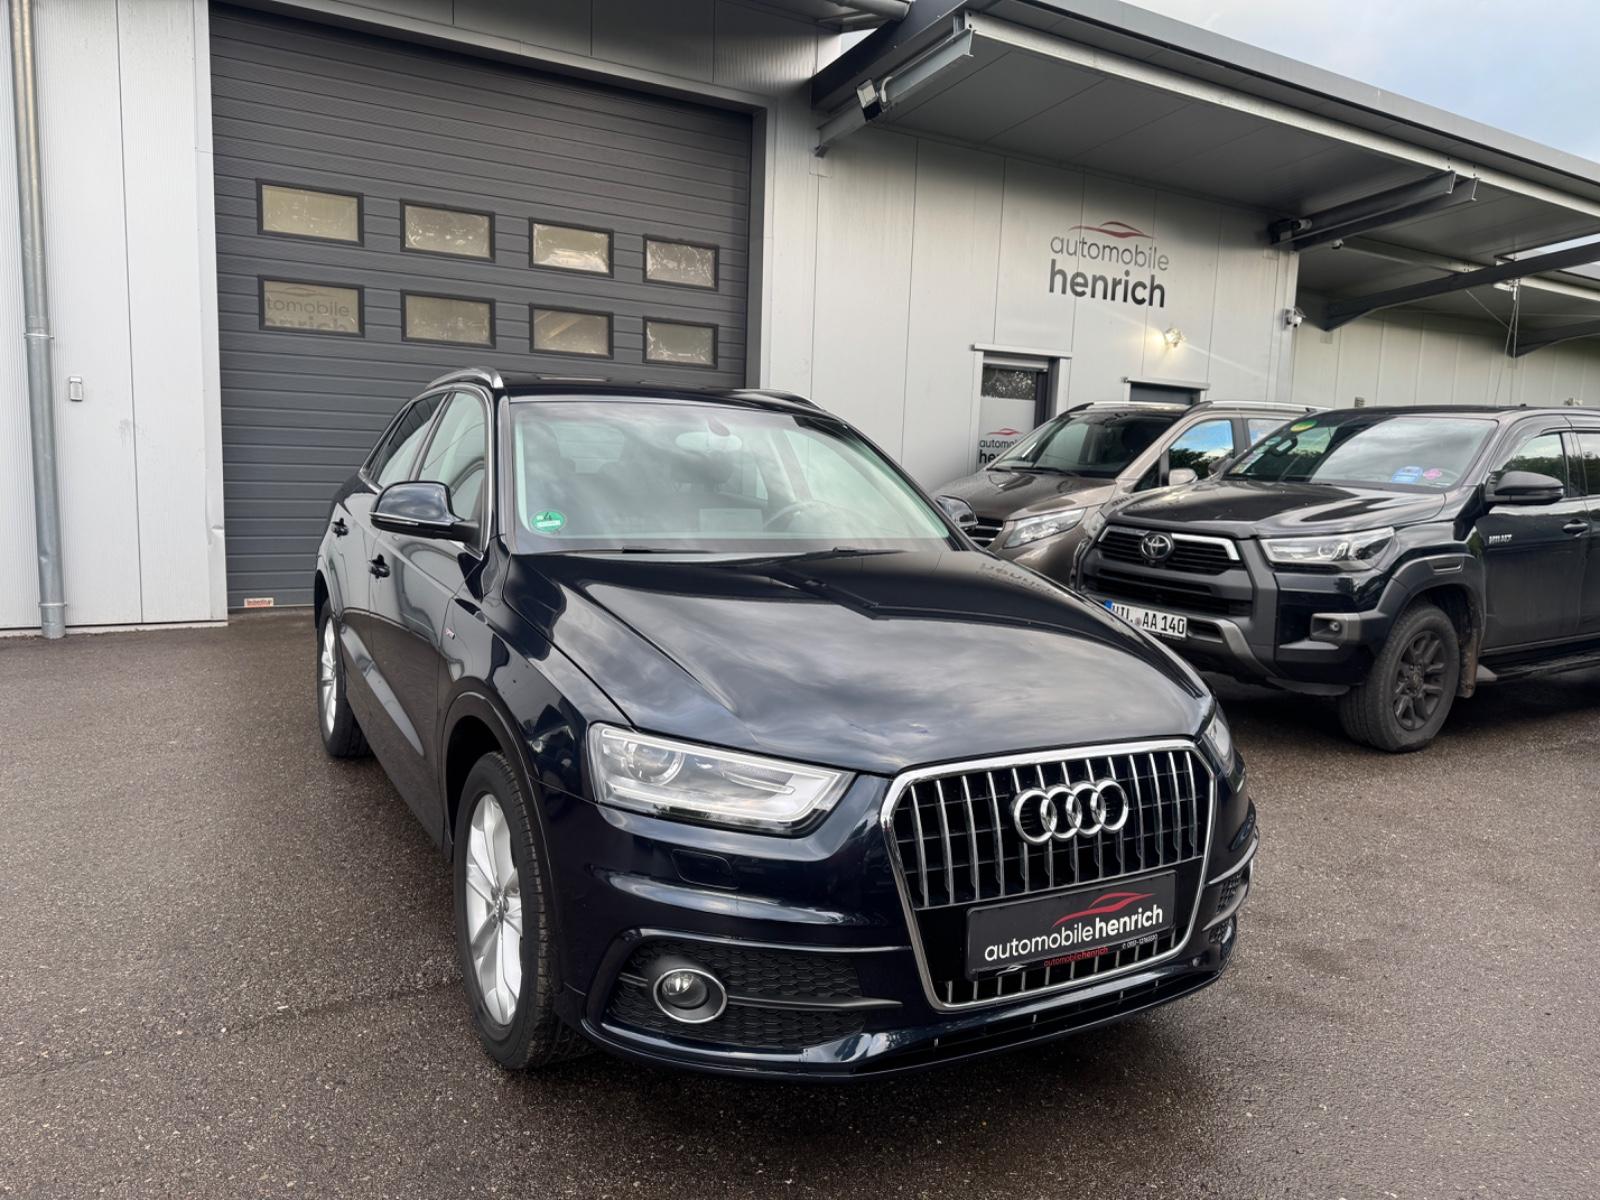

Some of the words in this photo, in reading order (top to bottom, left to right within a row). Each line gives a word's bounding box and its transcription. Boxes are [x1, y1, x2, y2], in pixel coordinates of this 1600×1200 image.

[1050, 236, 1169, 271] automobile
[1049, 258, 1165, 308] henrich
[979, 449, 1000, 464] he
[1142, 611, 1157, 630] AA
[1160, 615, 1185, 635] 140
[984, 904, 1163, 962] automobilehenrich
